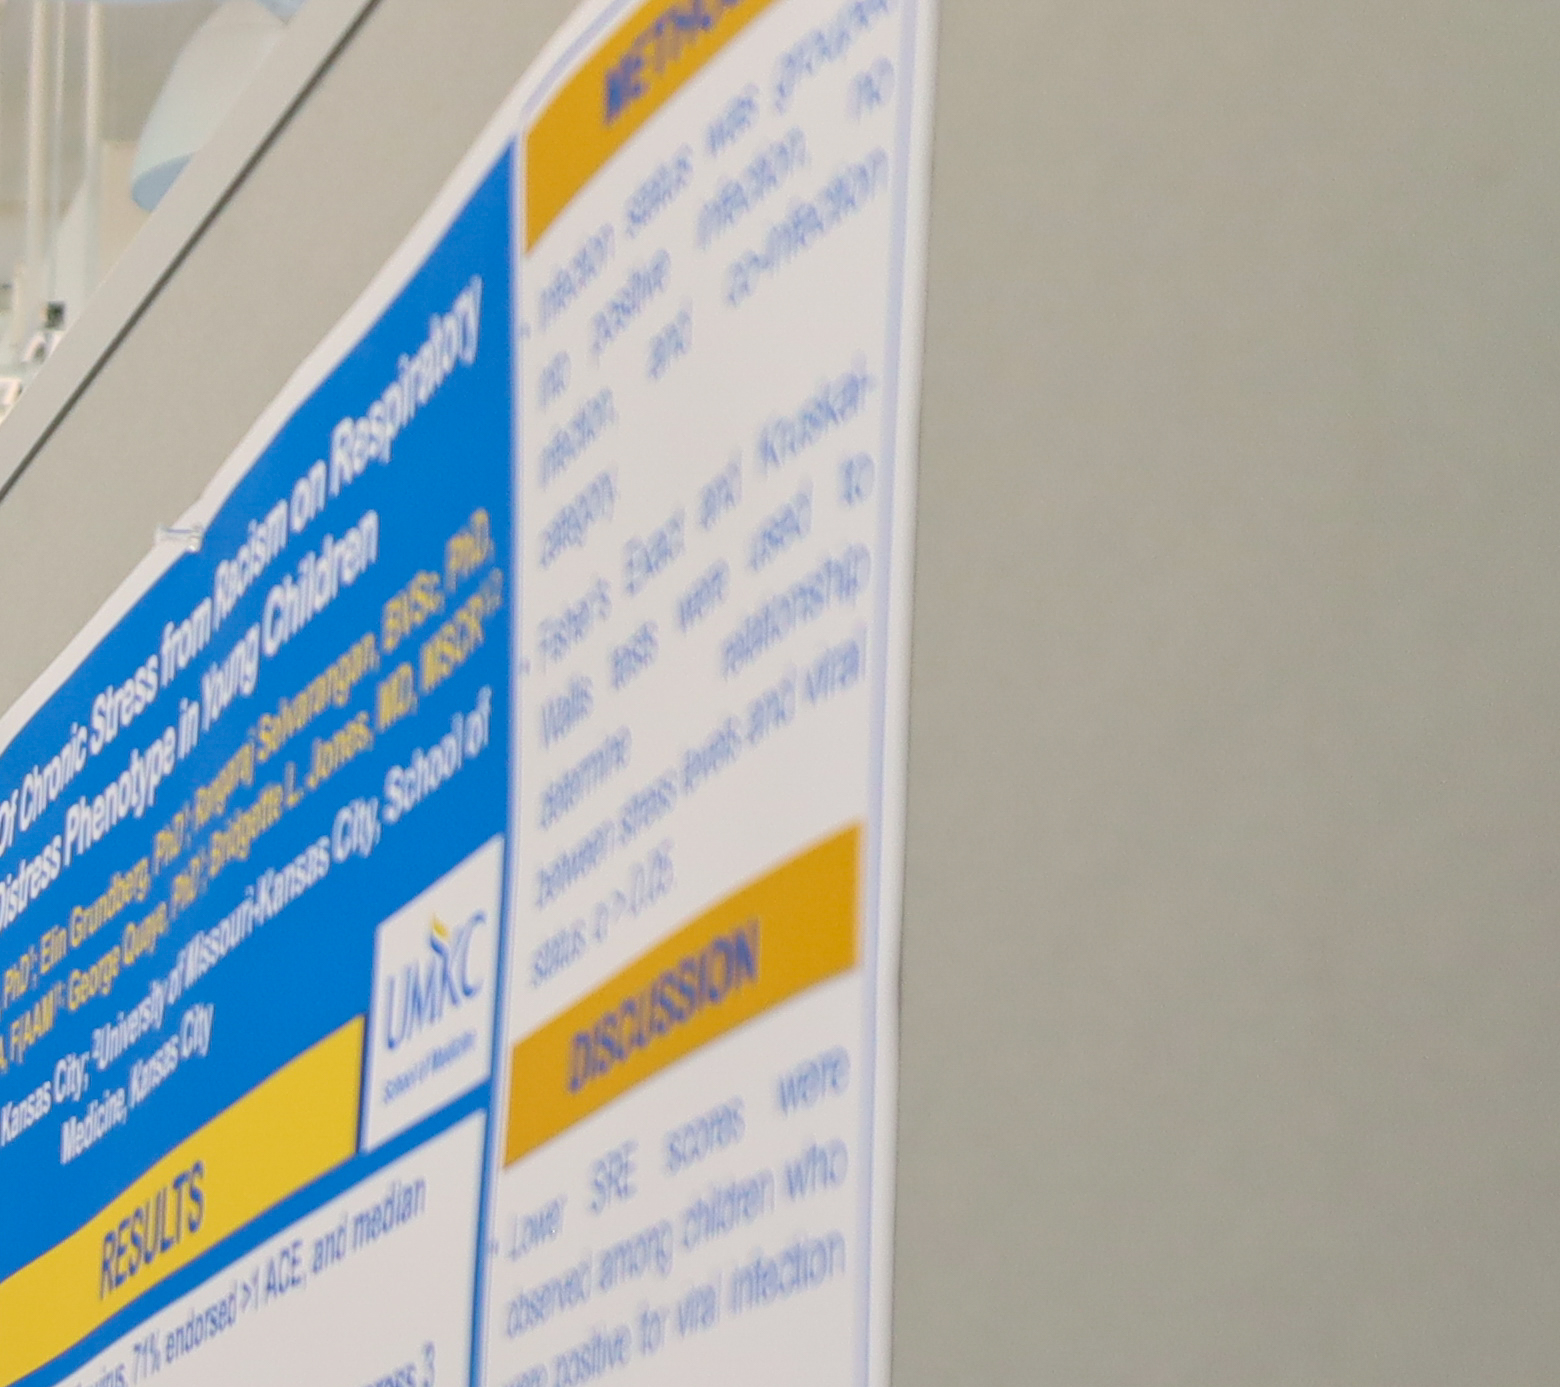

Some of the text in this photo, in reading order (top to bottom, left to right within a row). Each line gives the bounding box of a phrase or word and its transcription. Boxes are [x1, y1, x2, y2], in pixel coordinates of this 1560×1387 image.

[20, 724, 89, 832] Chronic
[89, 654, 159, 755] Stress
[160, 596, 212, 688] from
[212, 500, 288, 632] Racism
[290, 459, 326, 534] on
[329, 275, 483, 497] Respiratory
[63, 725, 177, 868] Phenotype
[178, 698, 200, 761] in
[201, 622, 261, 732] Young
[262, 509, 380, 657] Children
[1, 1076, 52, 1148] Kansas
[165, 948, 186, 1008] of
[184, 832, 331, 988] Missouri-Kansas
[382, 711, 465, 825] School
[465, 684, 492, 758] of
[387, 908, 488, 1051] UMKC
[567, 914, 761, 1093] DISCUSSION
[128, 1034, 180, 1109] Kansas
[180, 1002, 215, 1060] City
[588, 1139, 639, 1216] SRE
[663, 1096, 747, 1177] scores
[776, 1043, 852, 1118] were
[98, 1160, 209, 1301] RESULTS
[164, 1279, 238, 1365] endorsed
[310, 1210, 350, 1275] and
[351, 1175, 428, 1252] median
[504, 1135, 850, 1341] observed among children who
[674, 1267, 723, 1341] viral
[725, 1227, 847, 1316] infection
